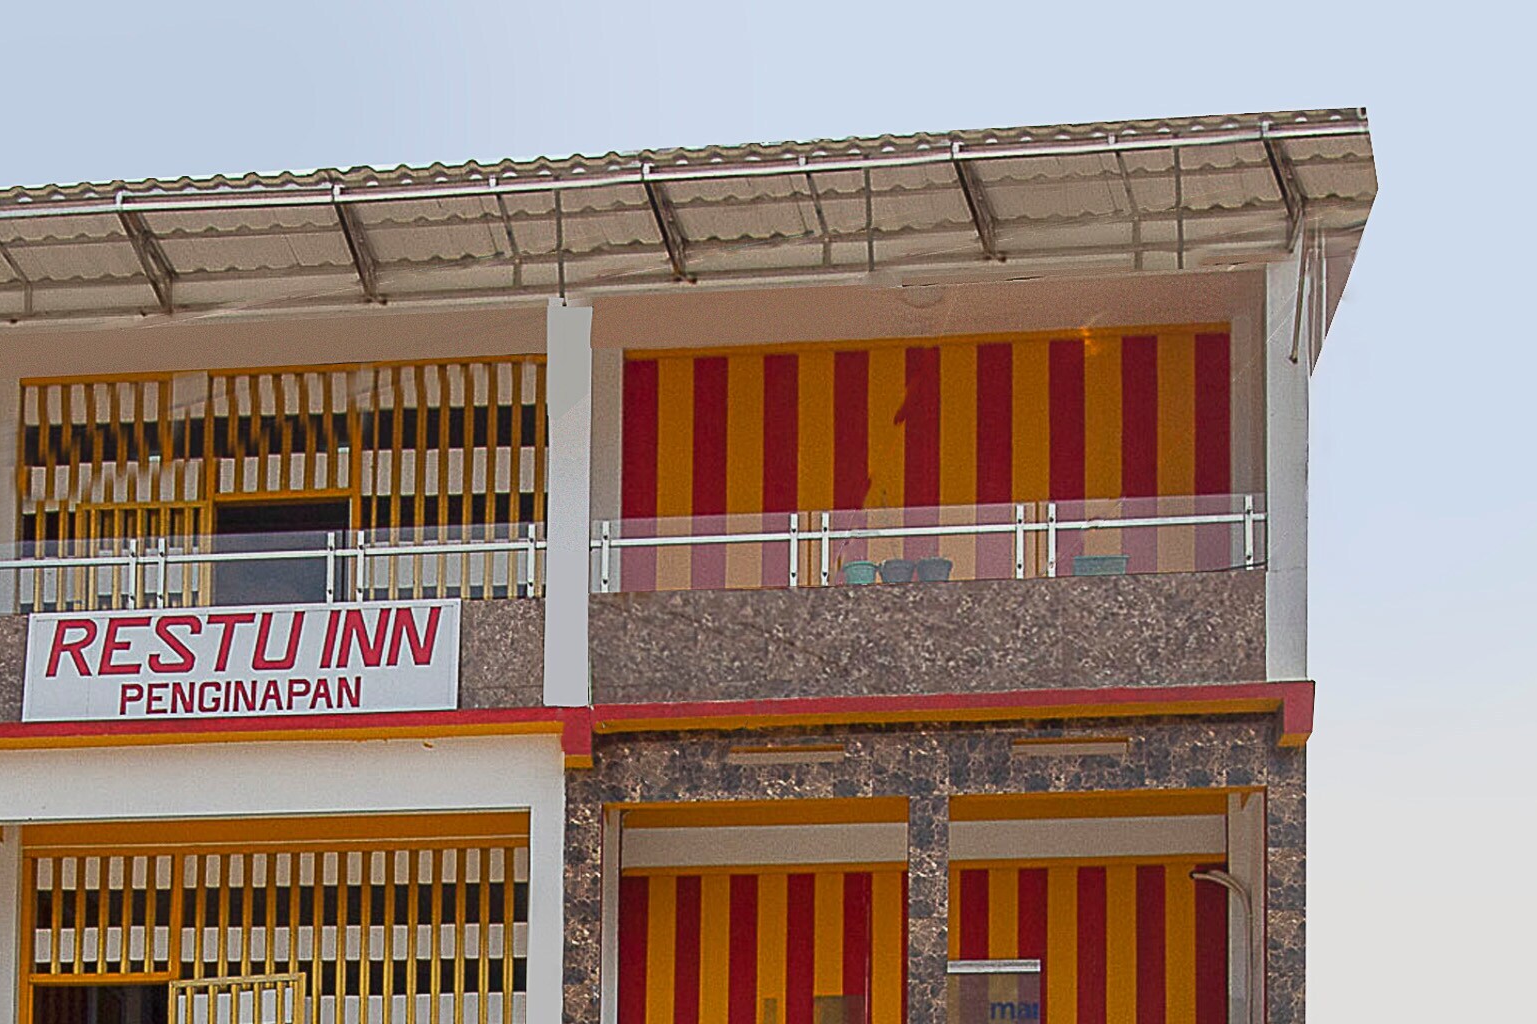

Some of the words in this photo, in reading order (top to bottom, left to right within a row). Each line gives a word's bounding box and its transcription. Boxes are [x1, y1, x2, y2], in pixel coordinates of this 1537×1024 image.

[45, 610, 305, 677] RESTU
[320, 606, 442, 669] INN
[120, 676, 362, 716] PENGINAPAN
